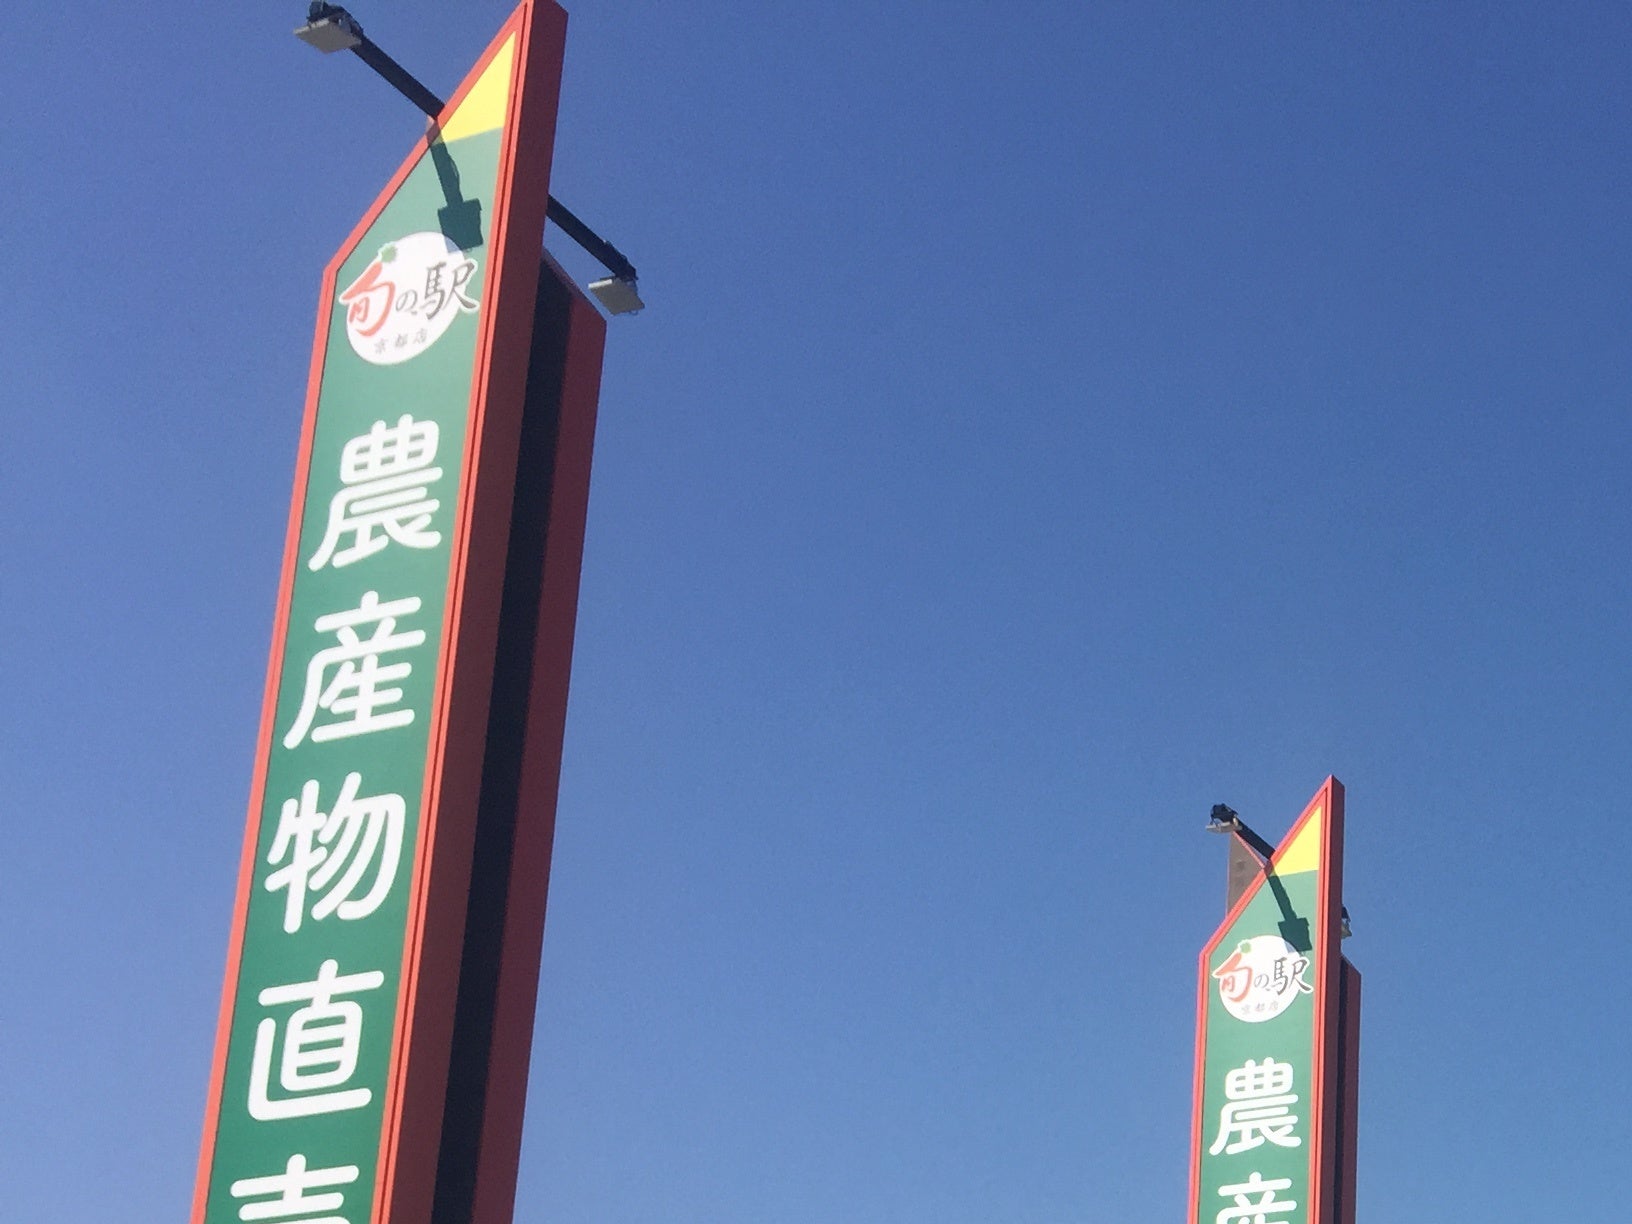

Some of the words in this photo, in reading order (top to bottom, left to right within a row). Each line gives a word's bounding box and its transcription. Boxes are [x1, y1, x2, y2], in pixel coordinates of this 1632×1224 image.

[342, 261, 478, 338] 旬の駅
[1214, 956, 1312, 1003] 旬の駅
